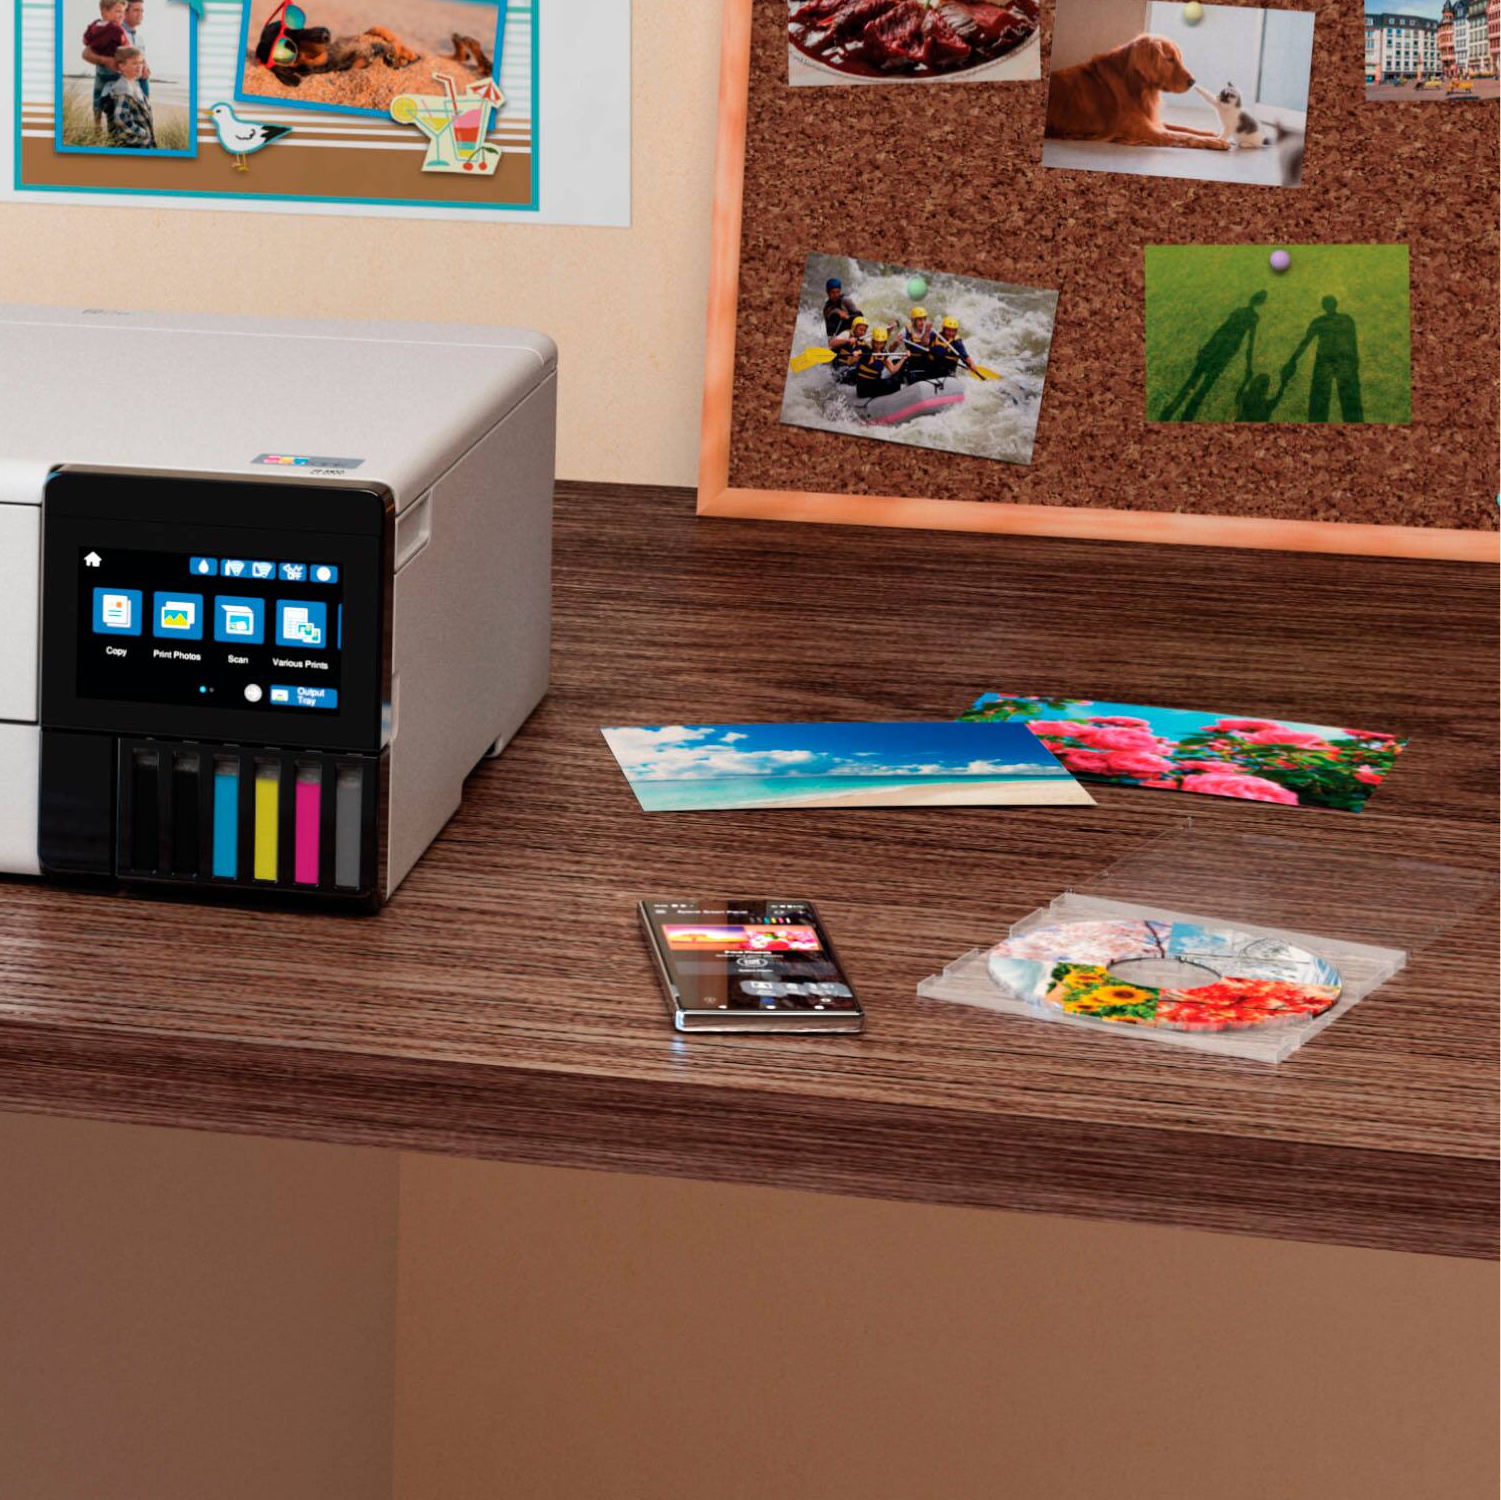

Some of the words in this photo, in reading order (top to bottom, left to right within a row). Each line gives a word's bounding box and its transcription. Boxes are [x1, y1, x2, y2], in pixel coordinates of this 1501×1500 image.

[105, 645, 128, 658] Copy
[153, 649, 173, 660] Print
[174, 650, 202, 662] Photos
[227, 654, 250, 665] Scan
[272, 657, 304, 669] Various
[305, 660, 329, 671] Prints
[297, 687, 325, 698] Output
[297, 695, 317, 707] Tray
